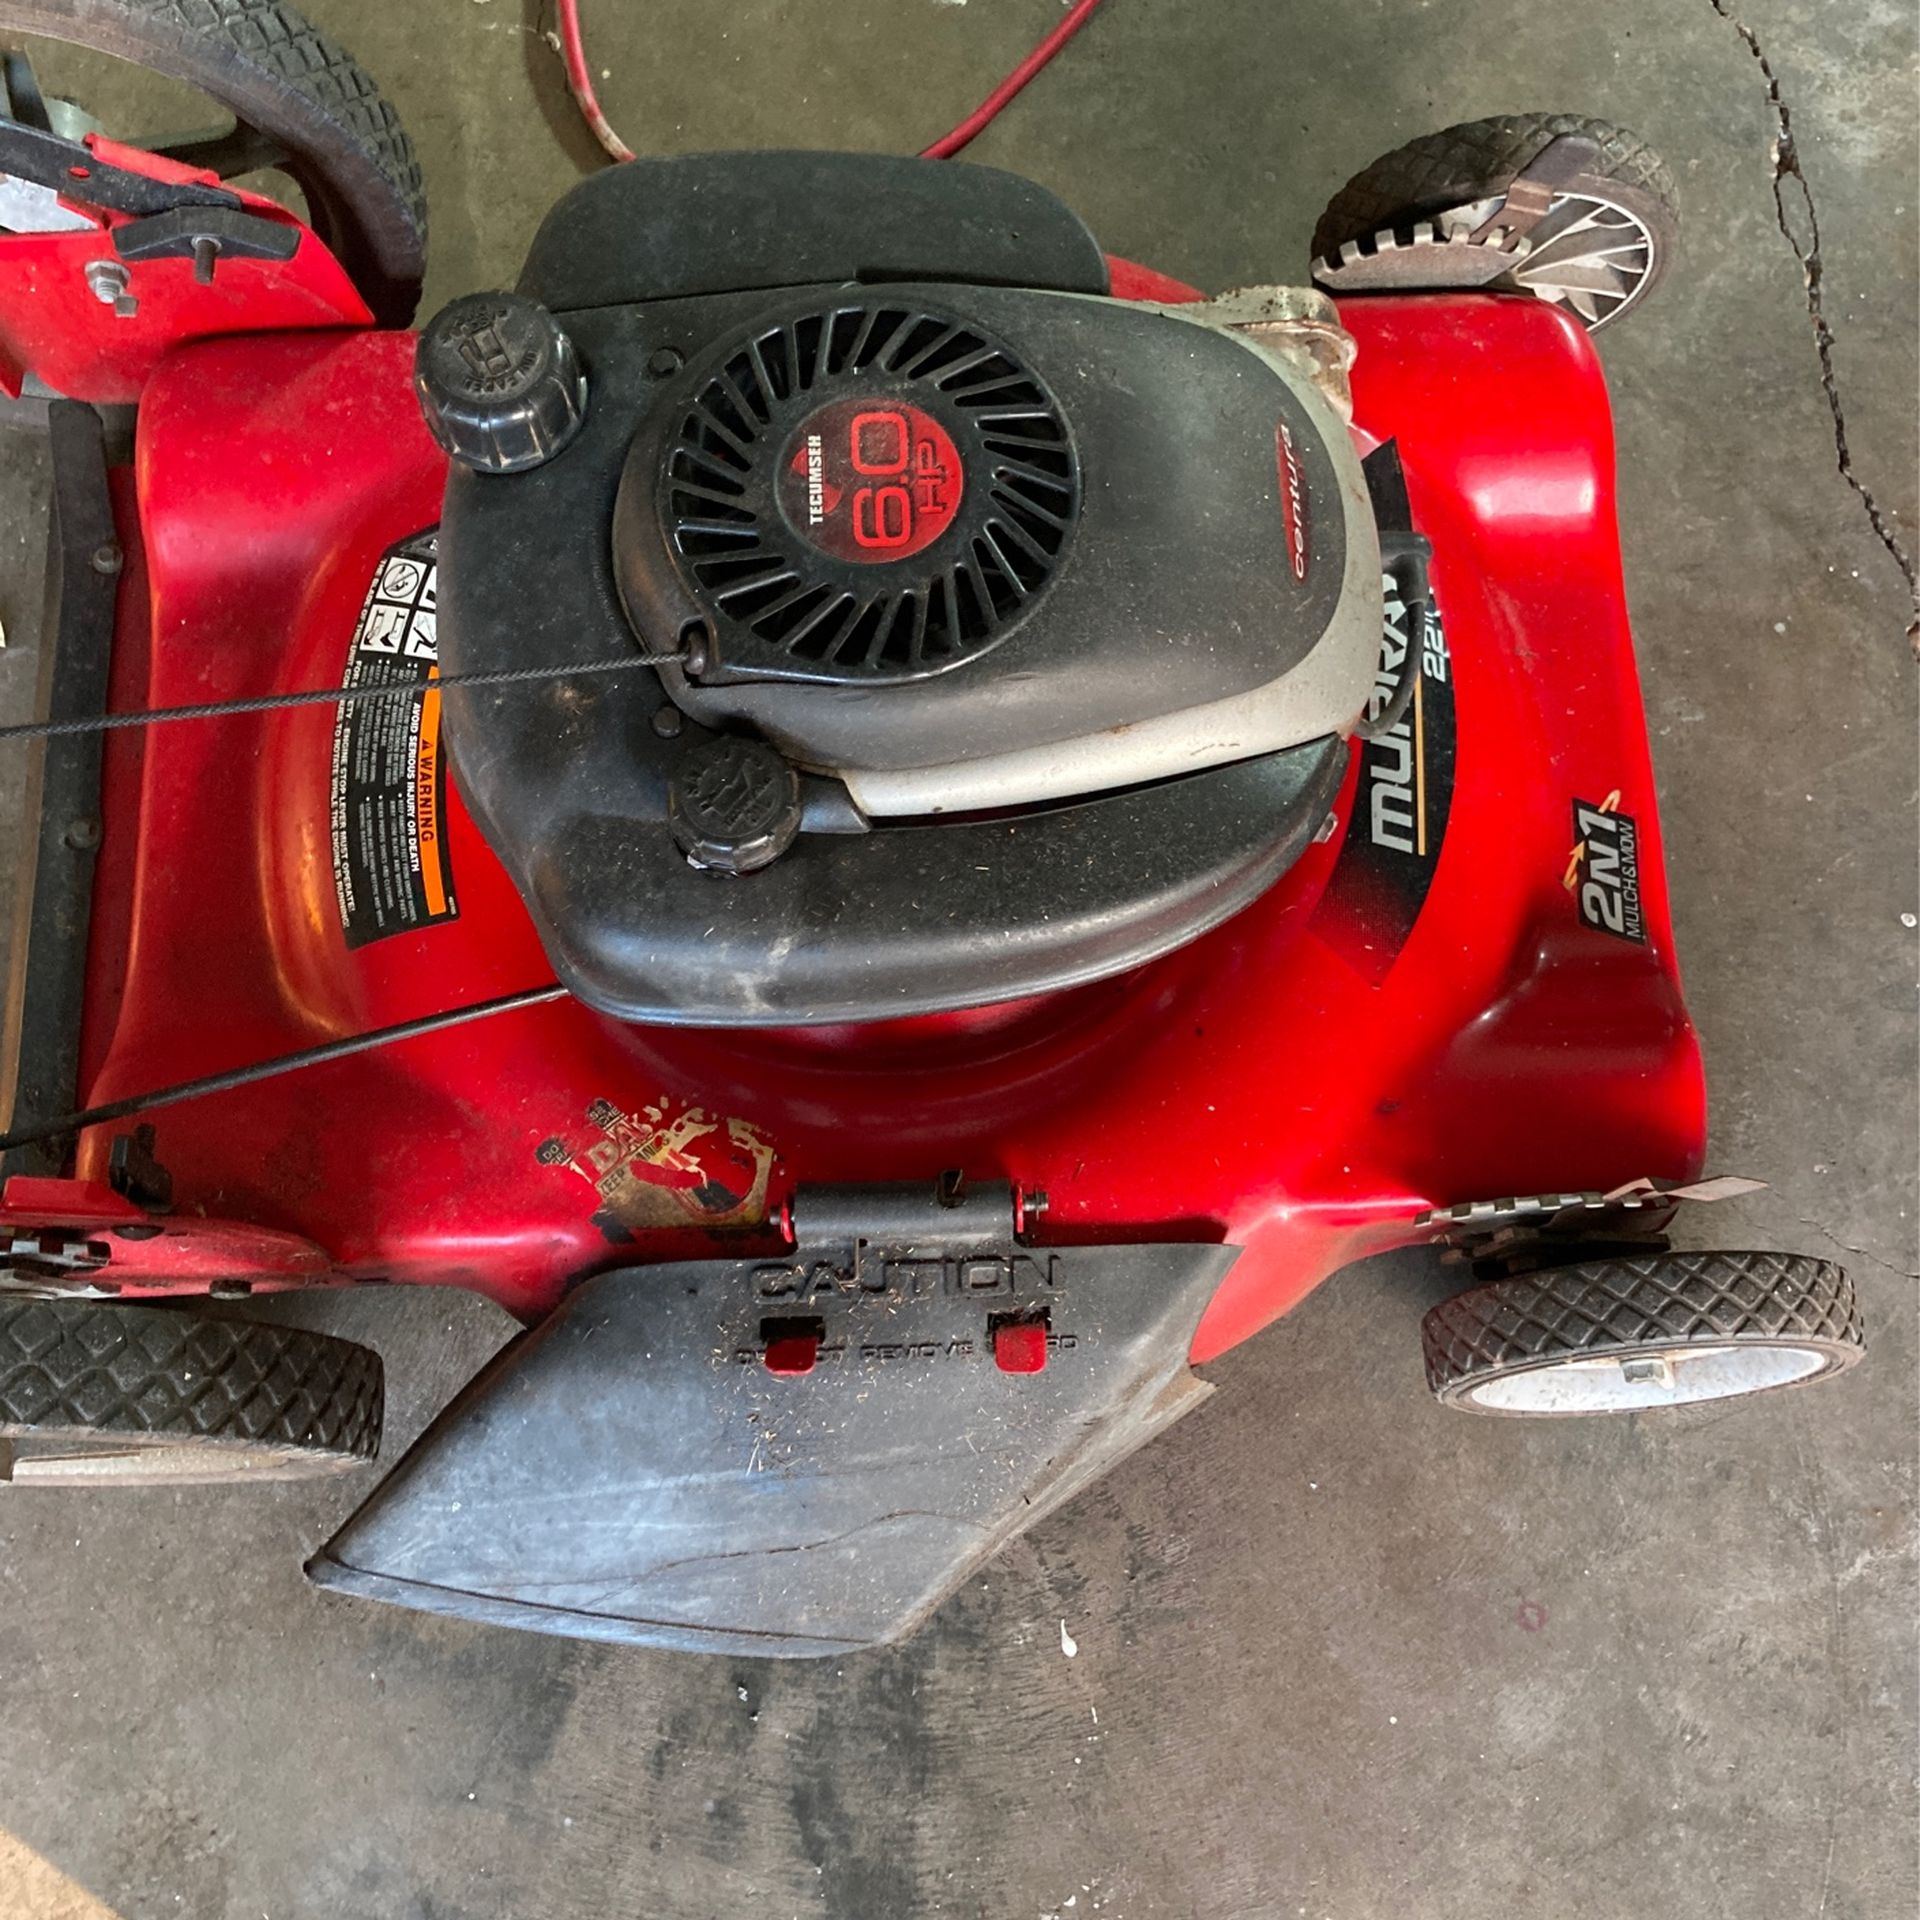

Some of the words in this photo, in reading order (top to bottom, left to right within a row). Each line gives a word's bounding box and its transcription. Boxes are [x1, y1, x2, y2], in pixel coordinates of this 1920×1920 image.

[808, 434, 823, 525] TECUMSEH
[850, 411, 911, 548] 6.0
[916, 438, 943, 514] HP
[1280, 423, 1304, 579] centura
[364, 578, 380, 608] BLADE
[352, 661, 363, 681] FOR
[334, 723, 343, 737] TO
[410, 702, 421, 734] AVOID
[331, 739, 341, 776] ROTATE
[341, 727, 351, 766] ENGINE
[407, 735, 418, 780] SERIOUS
[330, 776, 339, 808] WHILE
[339, 767, 348, 795] STOP
[338, 796, 347, 829] LEVER
[406, 782, 416, 818] INJURY
[419, 755, 434, 843] WARNING
[331, 809, 339, 830] THE
[407, 820, 417, 836] OR
[332, 831, 342, 868] ENGINE
[339, 830, 349, 860] MUST
[408, 837, 420, 872] DEATH
[334, 869, 342, 880] IS
[1578, 807, 1625, 933] 2N1
[748, 1252, 1063, 1304] CAUTION
[859, 1339, 975, 1362] REMOVE
